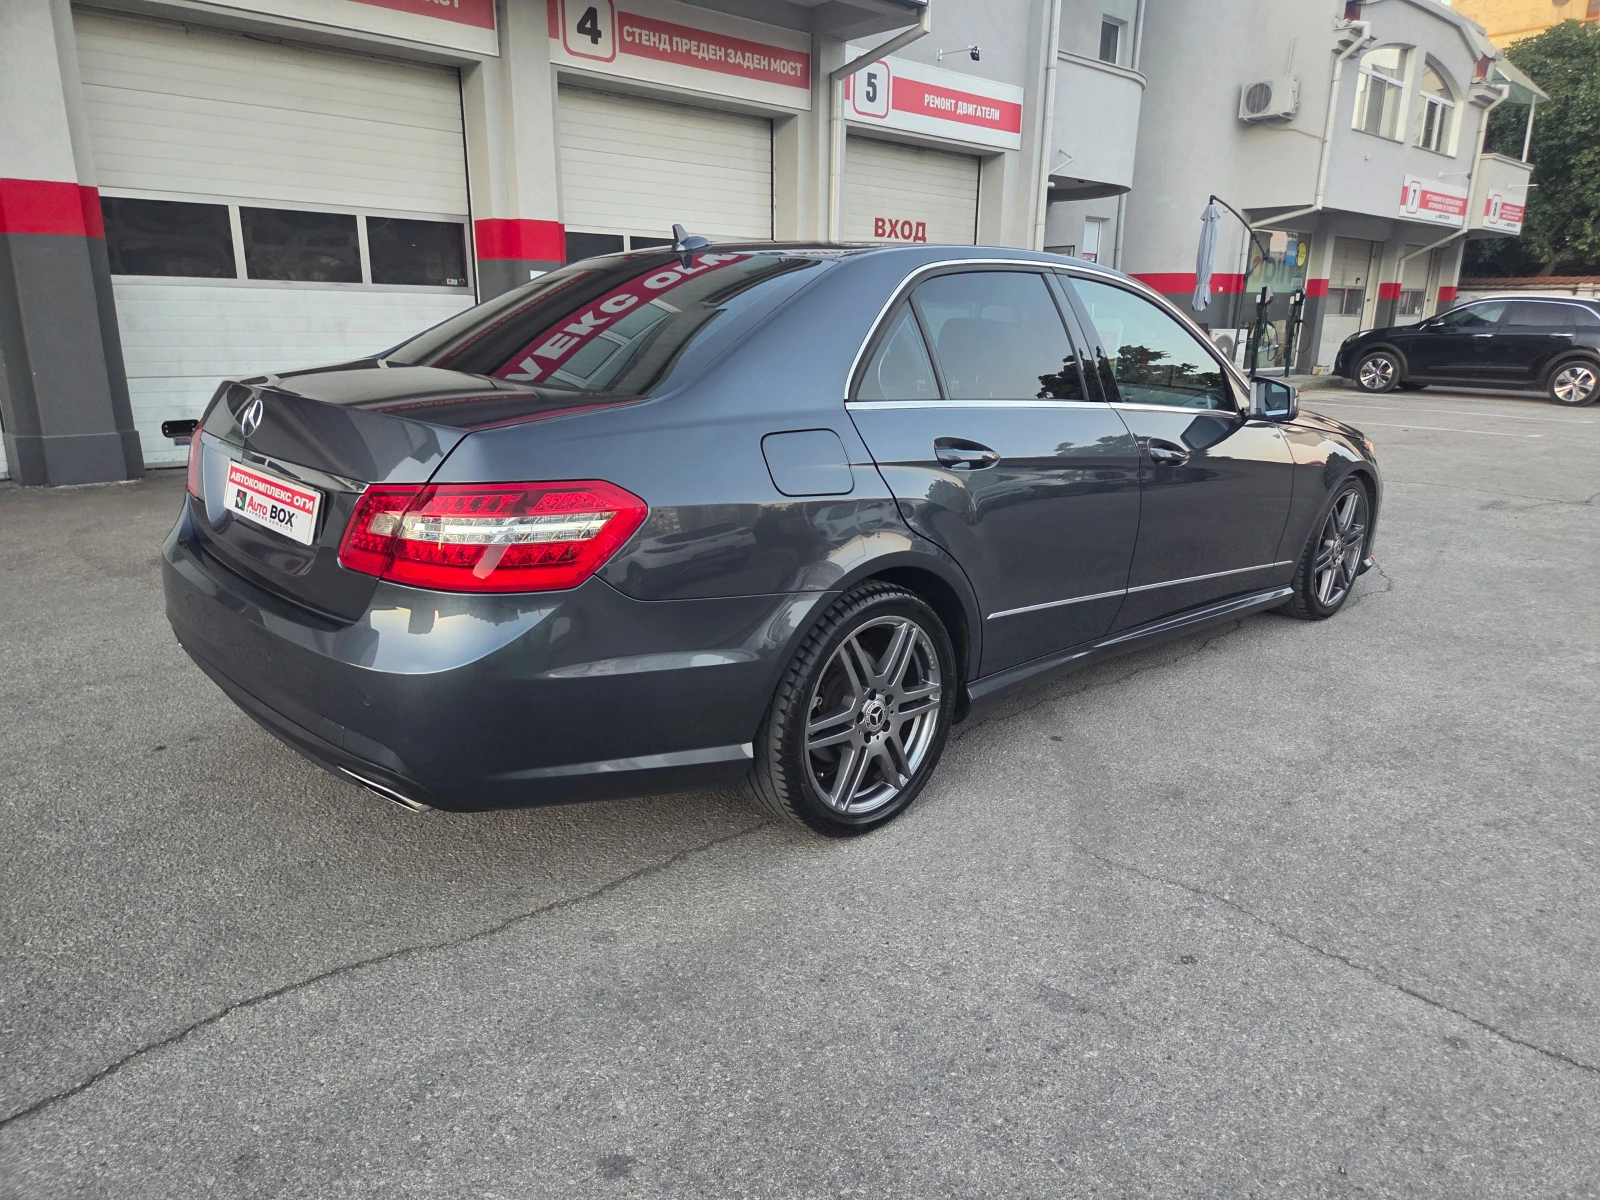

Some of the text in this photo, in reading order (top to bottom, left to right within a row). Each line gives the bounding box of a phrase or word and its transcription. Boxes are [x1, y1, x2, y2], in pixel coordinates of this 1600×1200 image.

[576, 6, 602, 45] 4
[622, 25, 802, 77] СТЕНД ПРЕДЕН ЗАДЕН МОСТ
[865, 72, 878, 103] 5
[924, 93, 1000, 121] РЕМОНТ ДВИГАТЕЛИ
[874, 217, 927, 243] ВХОД
[230, 471, 314, 512] АВТОКОМПЛЕКС ОГИ
[269, 504, 296, 528] BOX
